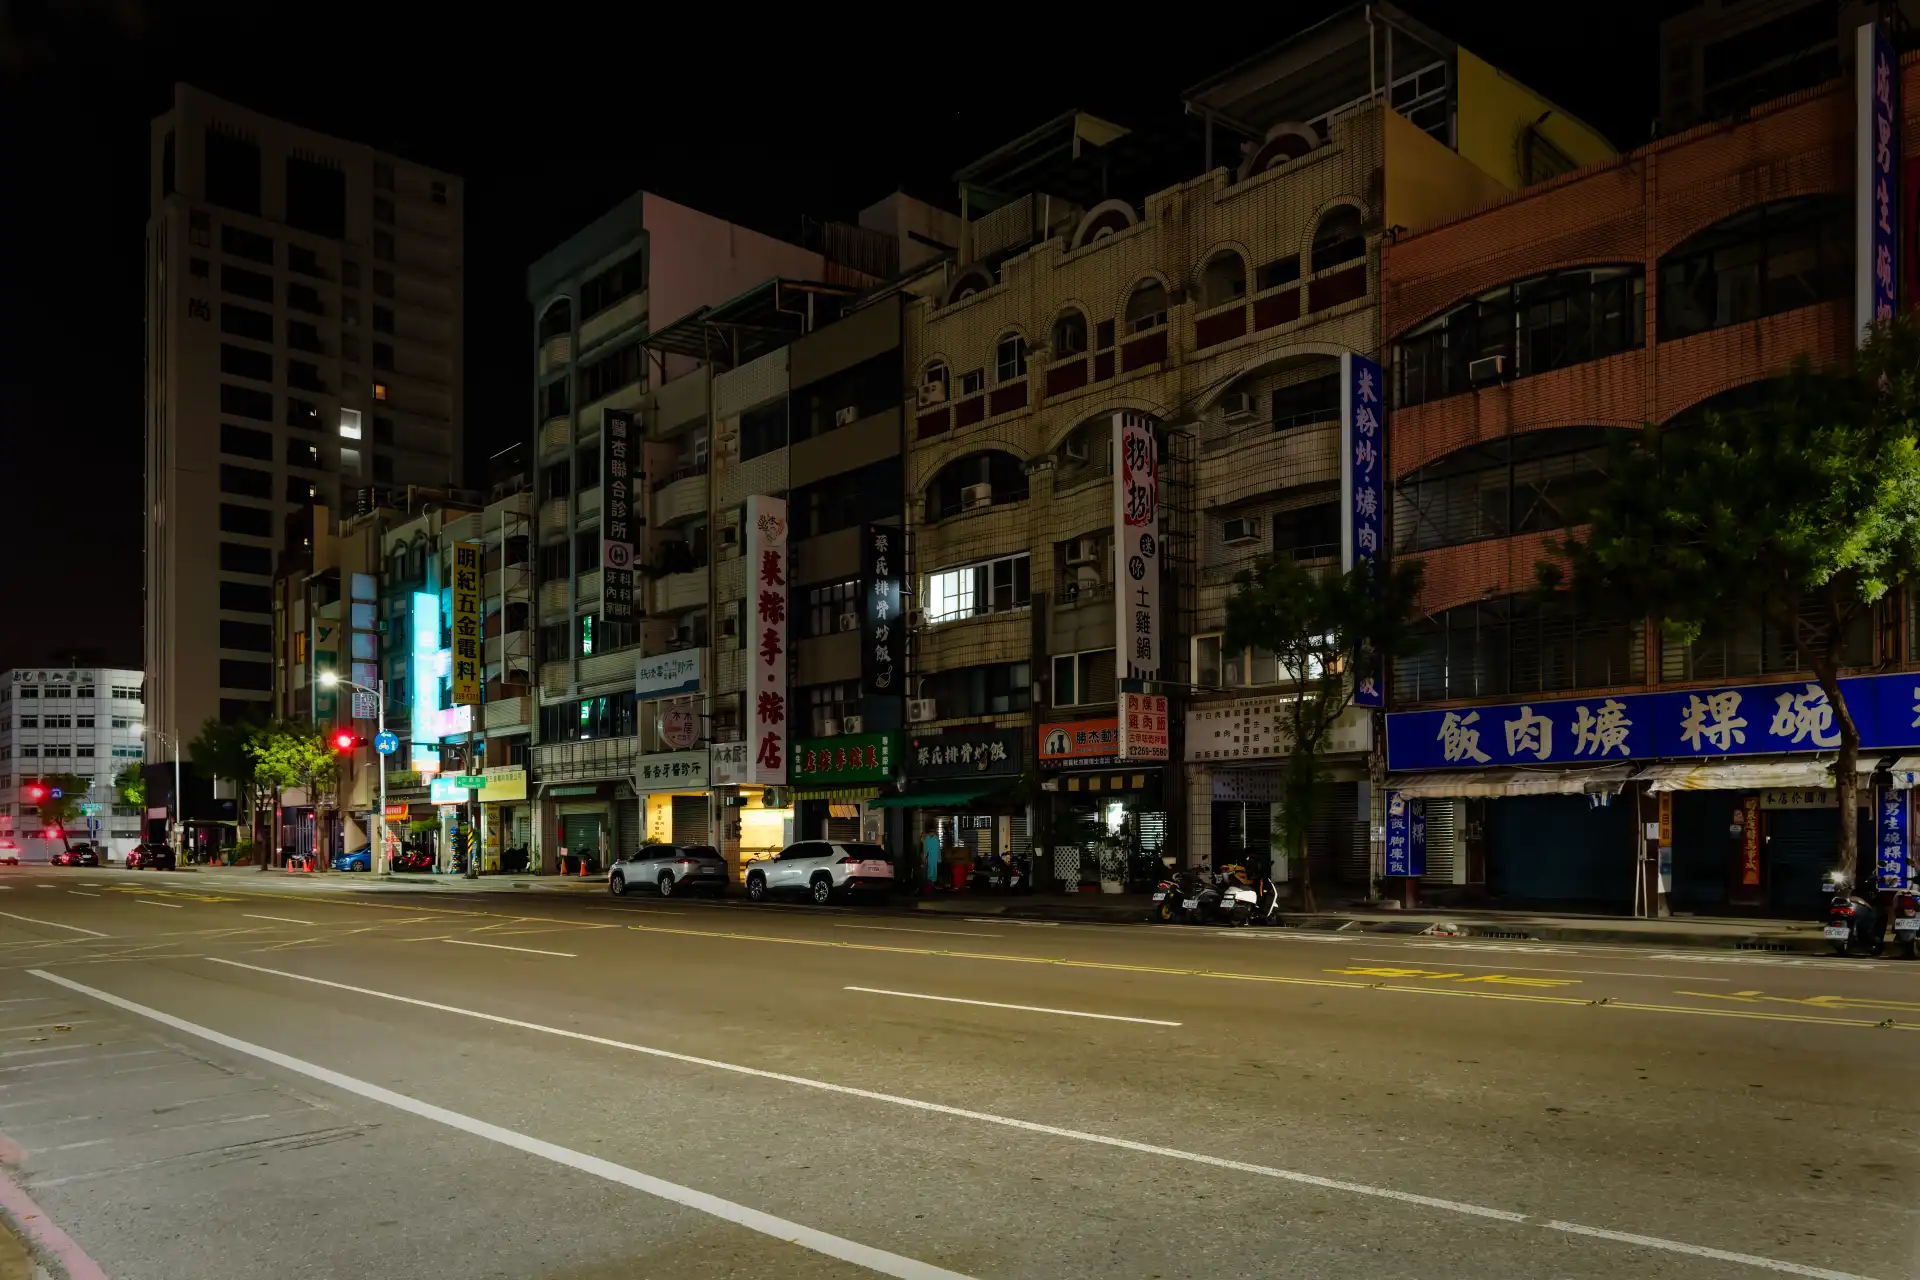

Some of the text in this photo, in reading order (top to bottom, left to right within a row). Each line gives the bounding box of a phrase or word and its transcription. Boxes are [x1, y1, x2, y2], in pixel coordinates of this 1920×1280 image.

[1126, 431, 1154, 526] 捌捌
[456, 547, 477, 682] 明紀五金電料
[874, 534, 892, 663] 蔡氏排骨炒飯
[1135, 586, 1151, 660] 土雞鍋
[1128, 713, 1167, 732] 雞肉飯
